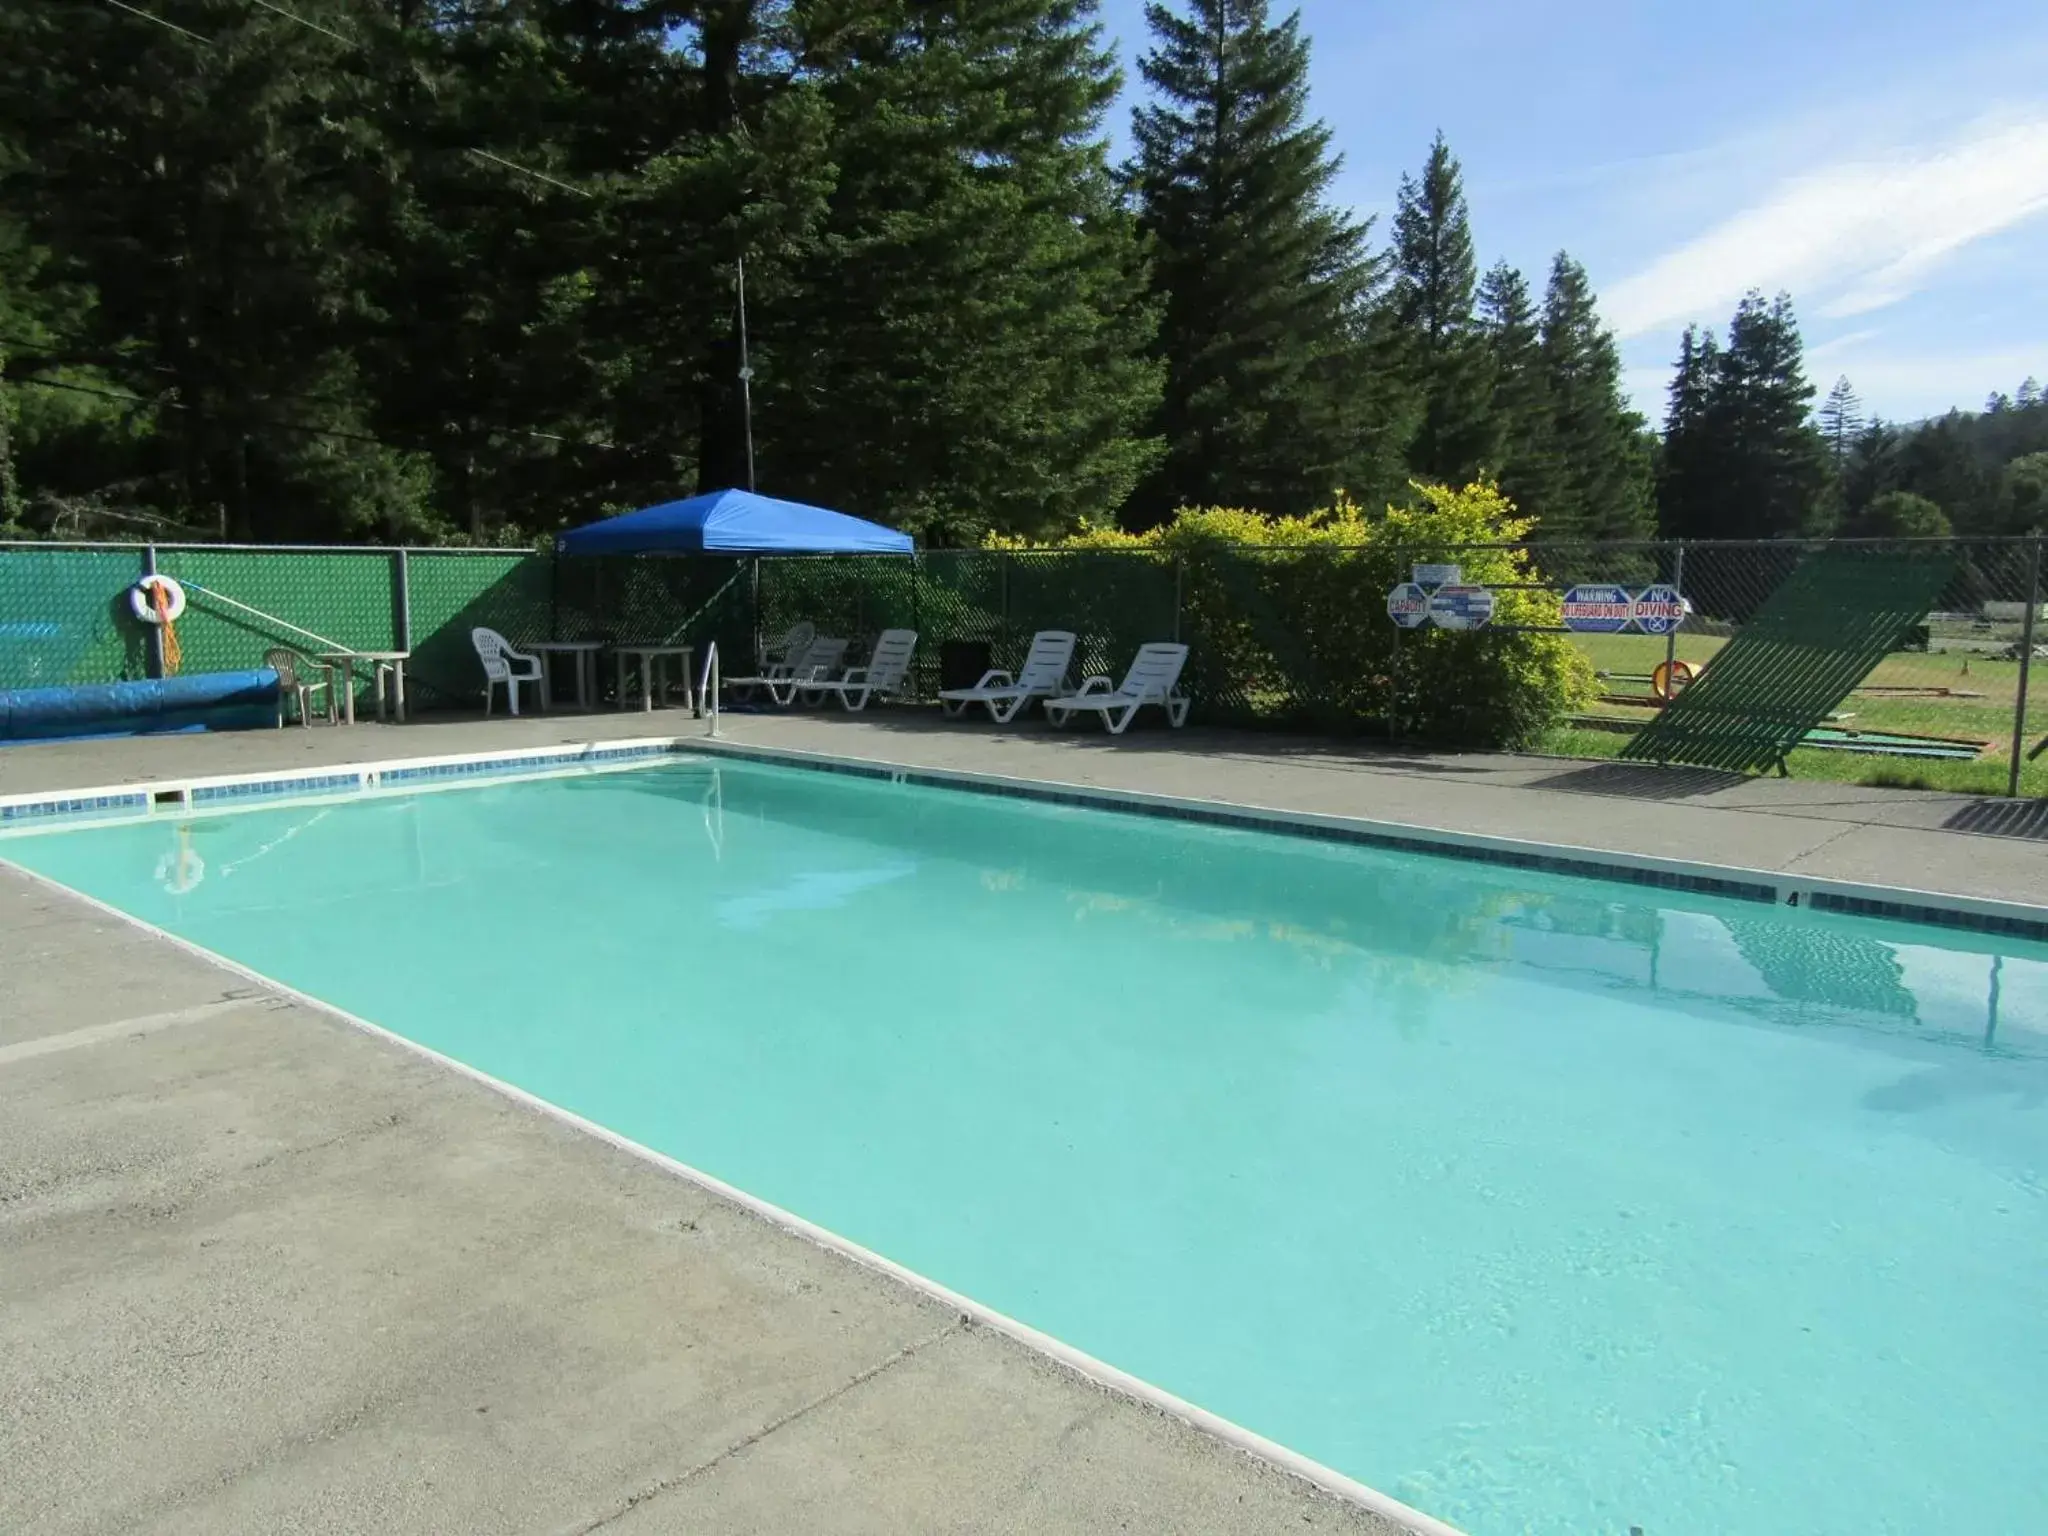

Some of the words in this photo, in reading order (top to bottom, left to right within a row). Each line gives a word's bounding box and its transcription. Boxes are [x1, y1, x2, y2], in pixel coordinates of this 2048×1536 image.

[1576, 588, 1617, 602] WARNING
[1651, 588, 1671, 602] NO
[1571, 604, 1603, 617] LIFEGUARD
[1635, 603, 1681, 617] DIVING
